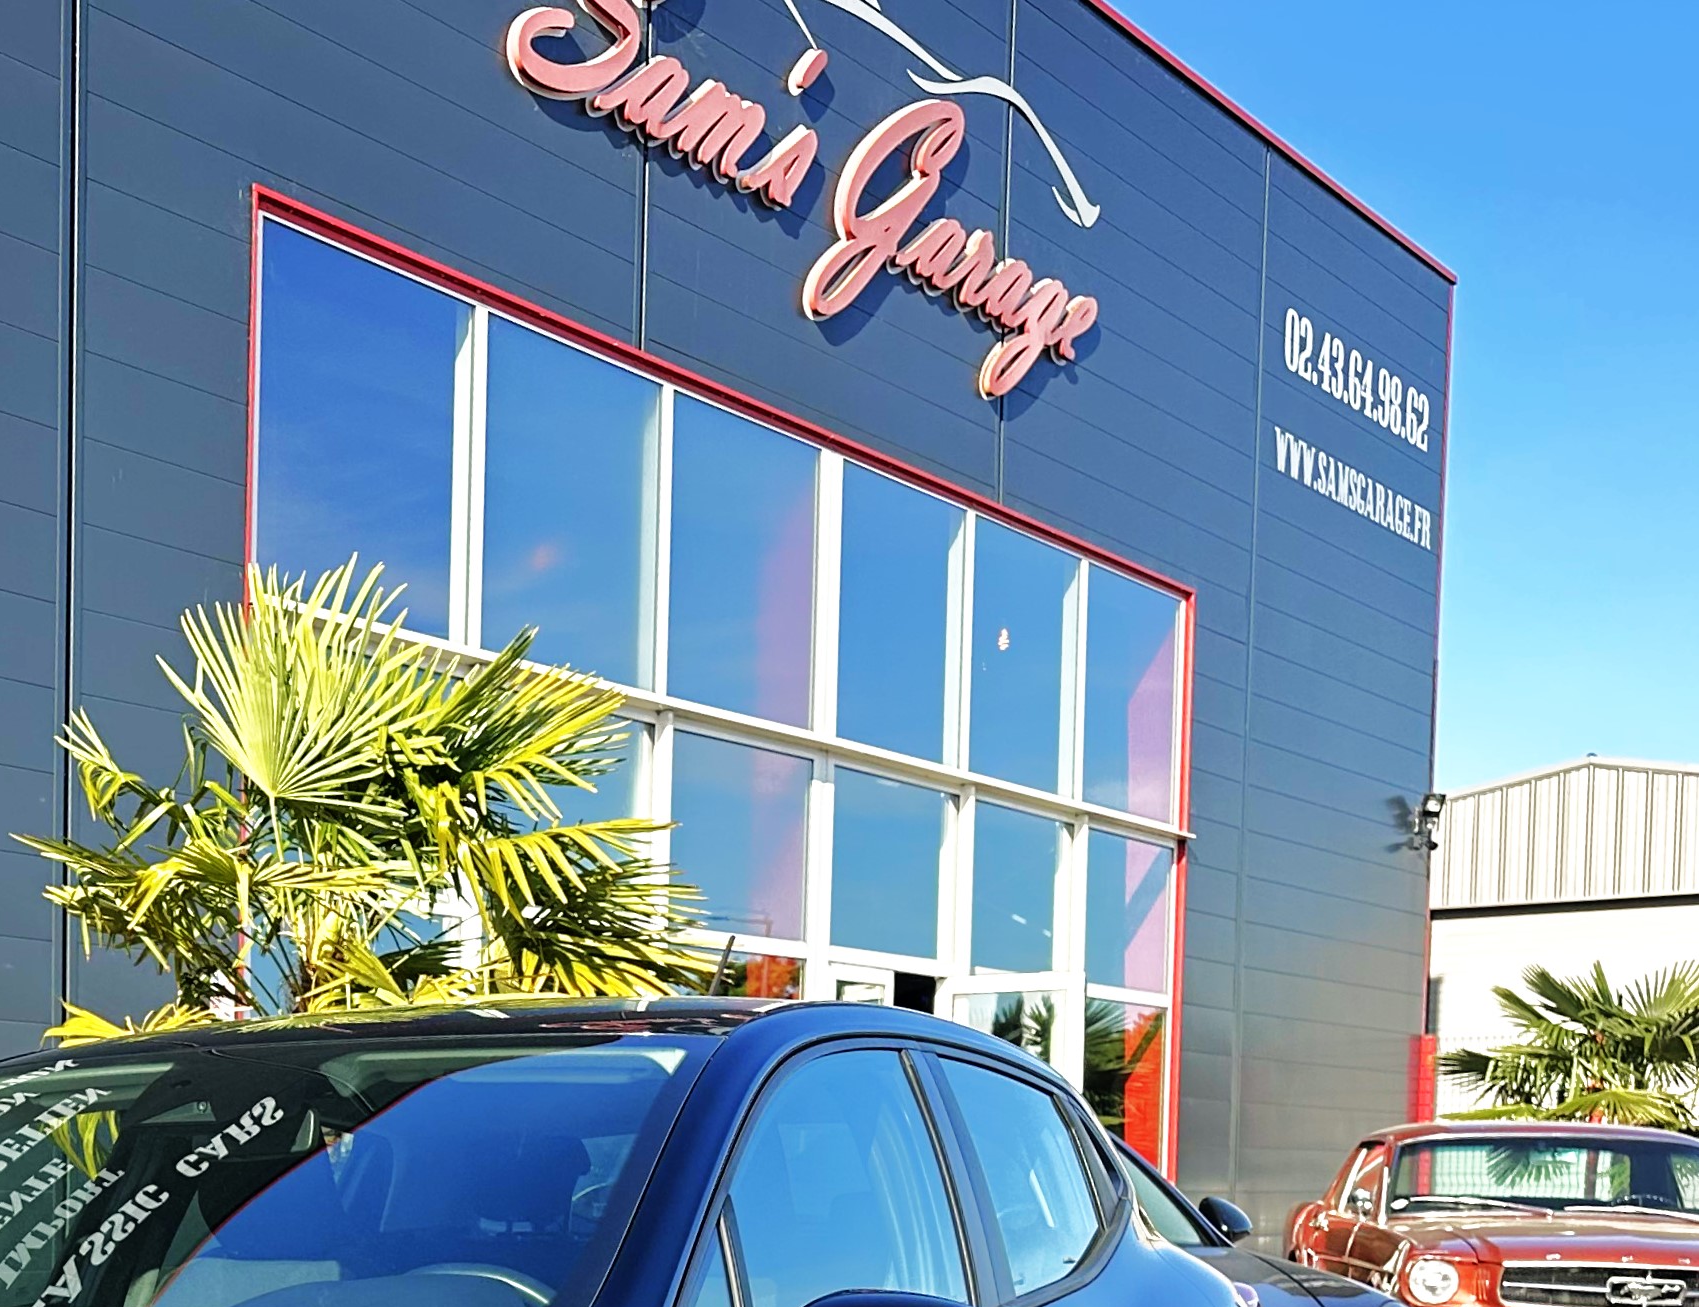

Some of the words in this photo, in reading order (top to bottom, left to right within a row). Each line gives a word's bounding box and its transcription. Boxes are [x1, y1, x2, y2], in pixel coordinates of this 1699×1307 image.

[802, 97, 1099, 401] Garage
[1283, 307, 1430, 453] 02.43.64.98.62
[1273, 425, 1432, 550] WWW.SAMSGARAGE.FR
